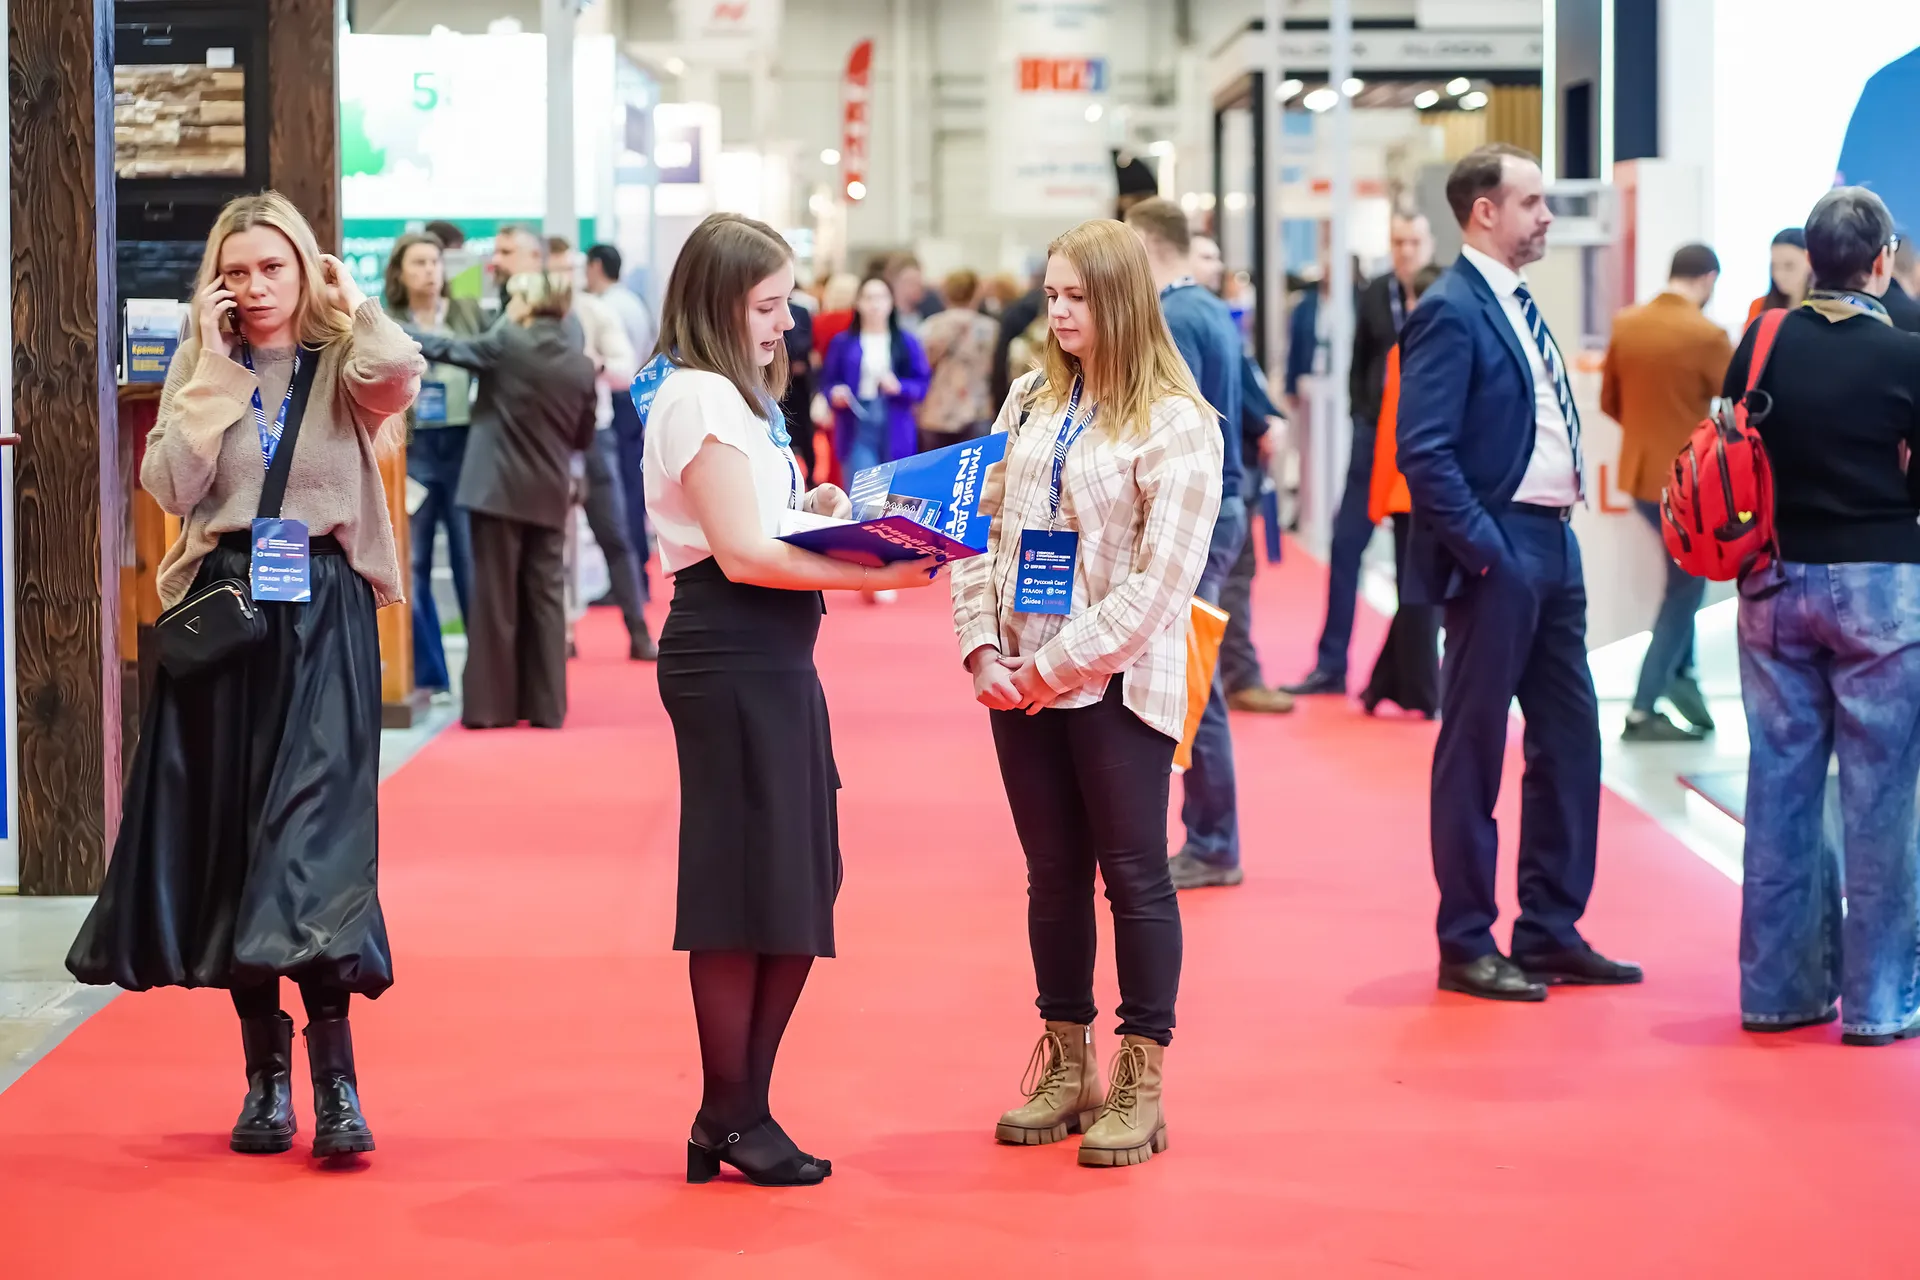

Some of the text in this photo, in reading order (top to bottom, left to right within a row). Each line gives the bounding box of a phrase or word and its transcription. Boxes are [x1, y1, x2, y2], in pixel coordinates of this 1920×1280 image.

[945, 447, 973, 537] INSYT
[961, 445, 984, 506] УМНЫЙ
[861, 524, 934, 556] INSYT
